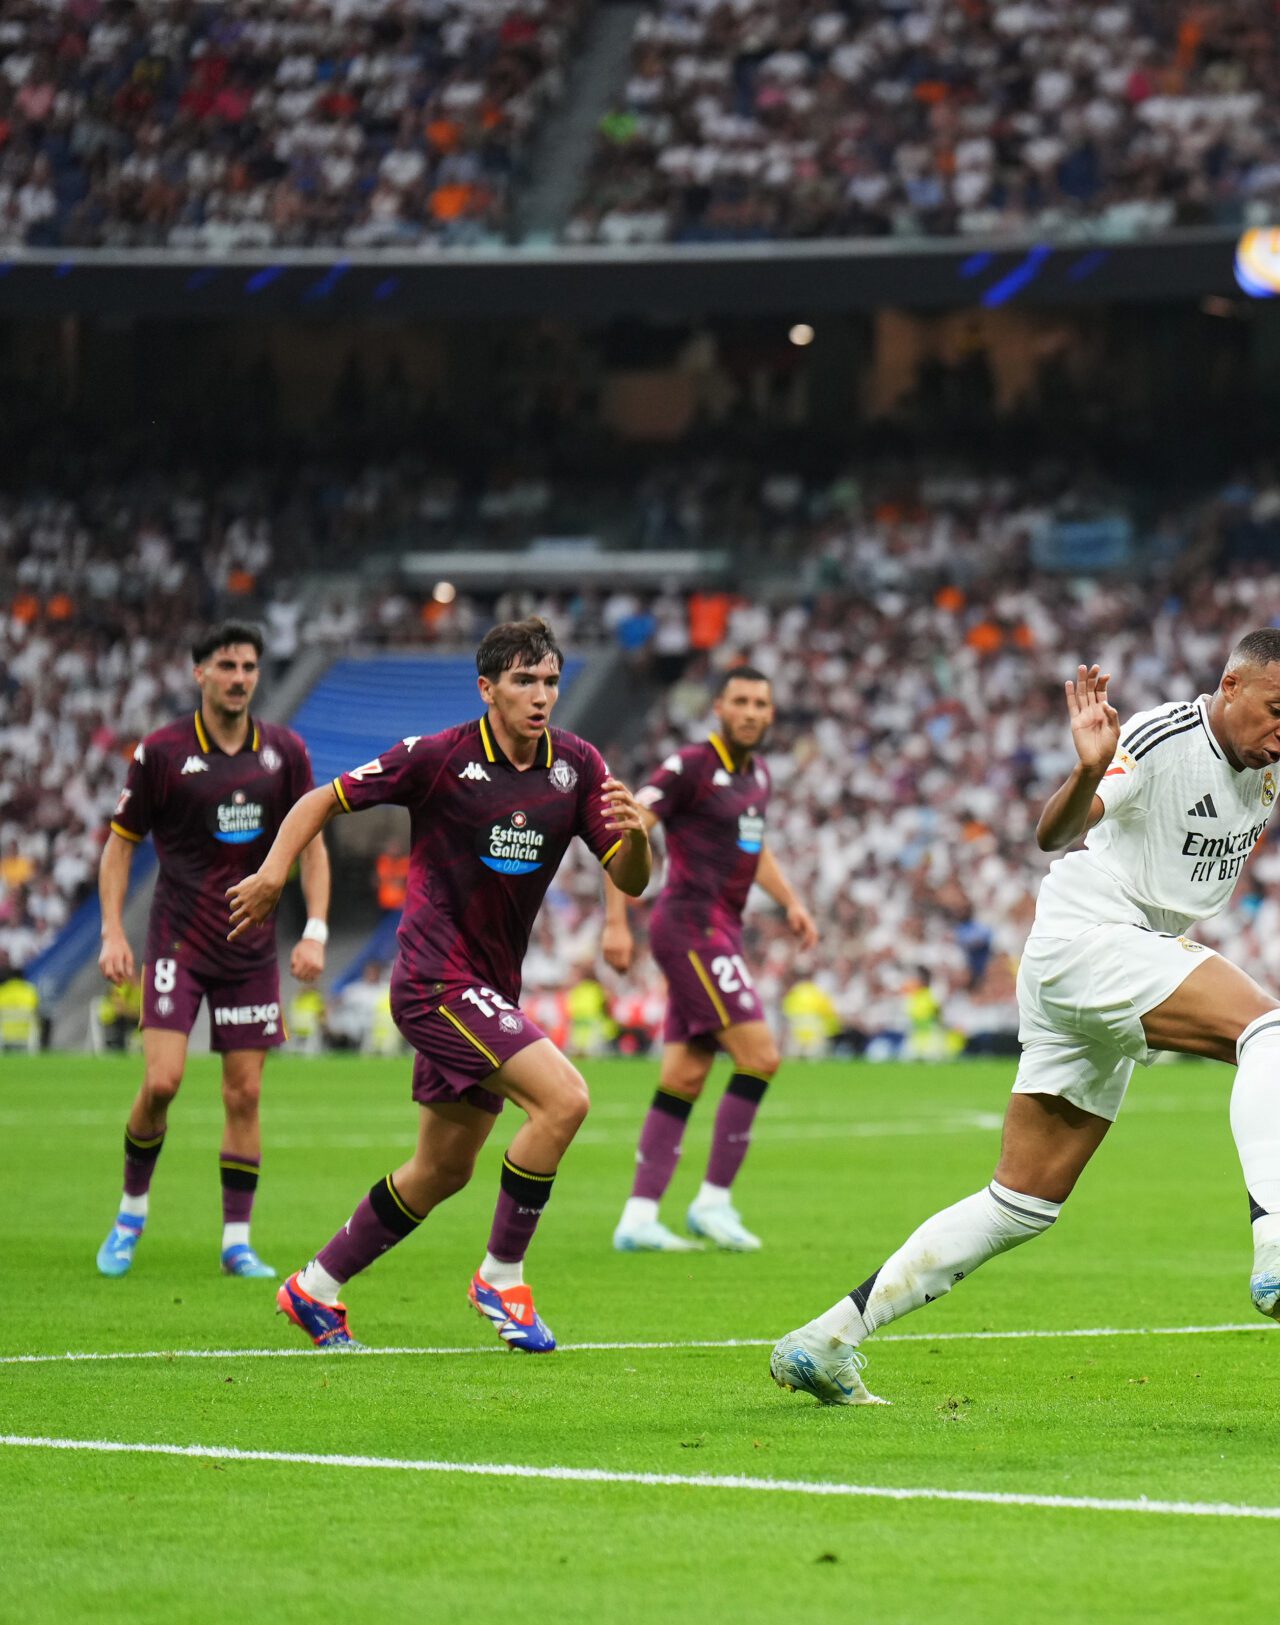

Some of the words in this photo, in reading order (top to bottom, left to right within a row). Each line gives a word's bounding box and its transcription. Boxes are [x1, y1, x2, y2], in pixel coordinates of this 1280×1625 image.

[489, 824, 544, 846] Estrella
[489, 840, 538, 860] Galicia
[1190, 860, 1216, 882] FLY
[154, 957, 177, 993] 8
[711, 954, 752, 993] 21
[214, 1002, 279, 1026] INEXO
